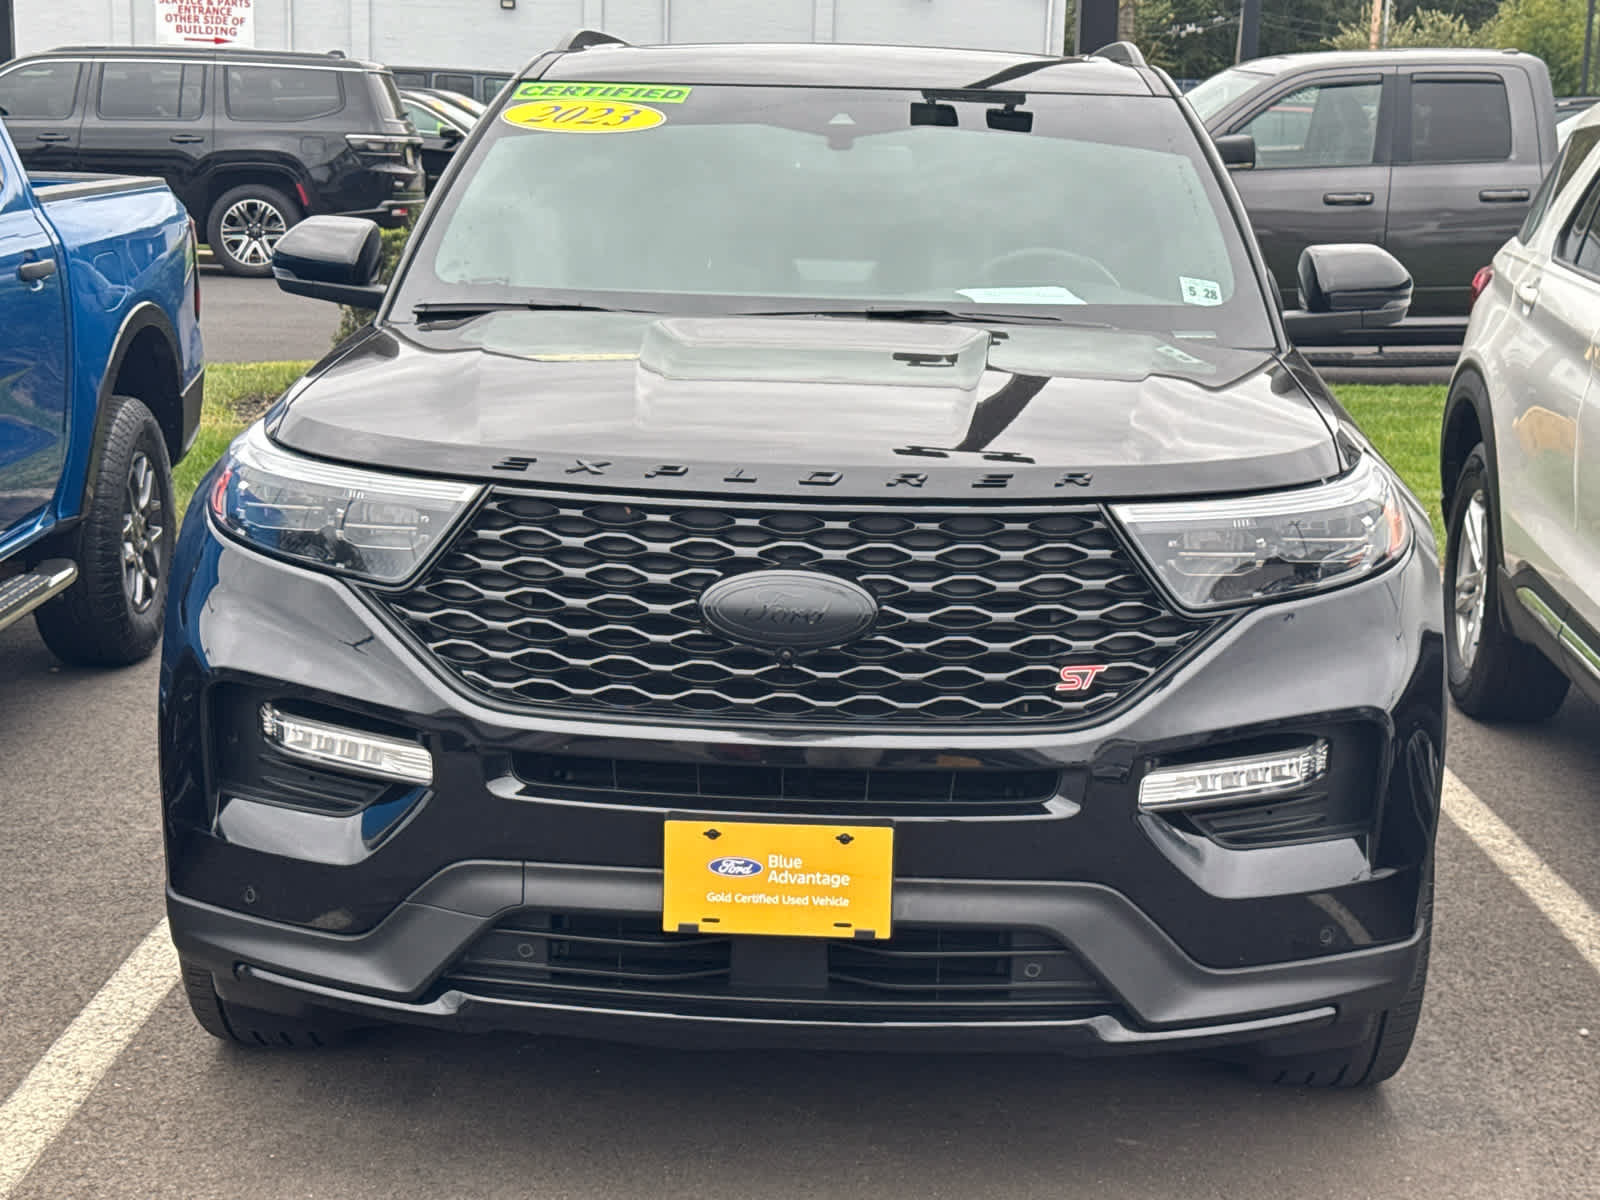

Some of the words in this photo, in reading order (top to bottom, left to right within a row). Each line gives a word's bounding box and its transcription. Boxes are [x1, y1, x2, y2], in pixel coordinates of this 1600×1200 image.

[177, 5, 233, 16] ENTRANCE
[217, 0, 252, 8] PARTS
[165, 14, 200, 24] OTHER
[203, 16, 229, 26] SIDE
[232, 17, 246, 26] OF
[176, 25, 238, 36] BUILDING
[519, 85, 684, 99] CERTIFIED
[521, 105, 642, 127] 2023
[1188, 286, 1197, 297] 5
[492, 456, 1094, 489] EXPLORER
[742, 591, 832, 625] Ford
[1055, 664, 1108, 691] ST
[717, 859, 752, 875] Ford
[768, 854, 803, 869] Blue
[767, 870, 851, 888] Advantage
[706, 891, 732, 904] Gold
[734, 892, 779, 905] Certified
[782, 894, 809, 906] Used
[812, 895, 850, 907] Vehicle
